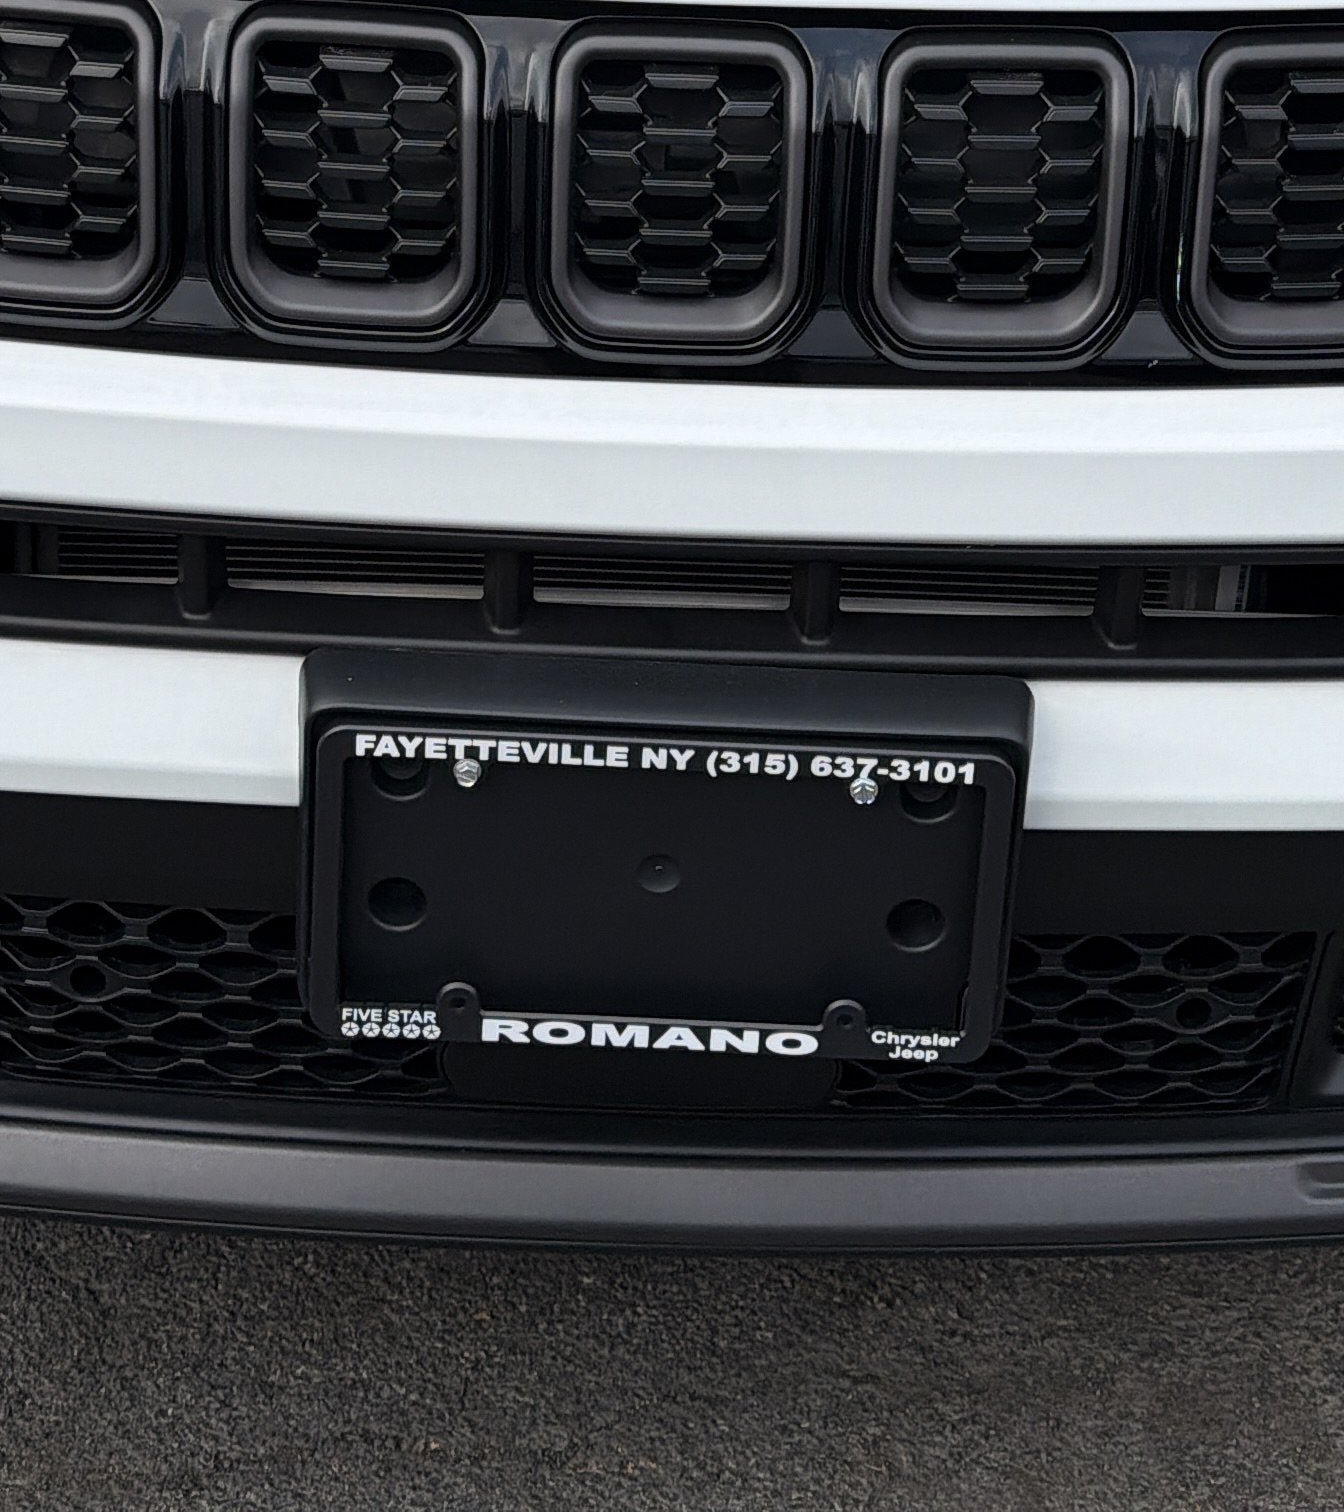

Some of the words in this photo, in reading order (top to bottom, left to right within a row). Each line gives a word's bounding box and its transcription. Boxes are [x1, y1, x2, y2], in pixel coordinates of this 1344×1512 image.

[355, 733, 629, 768] FAYETTEVILLE
[641, 746, 696, 771] NY
[706, 750, 799, 781] (315)
[810, 755, 976, 785] 637-3101
[341, 1007, 383, 1022] FIVE
[387, 1009, 437, 1024] STAR
[481, 1018, 819, 1055] ROMANO
[871, 1030, 961, 1048] Chrysler
[888, 1045, 939, 1063] Jeep
